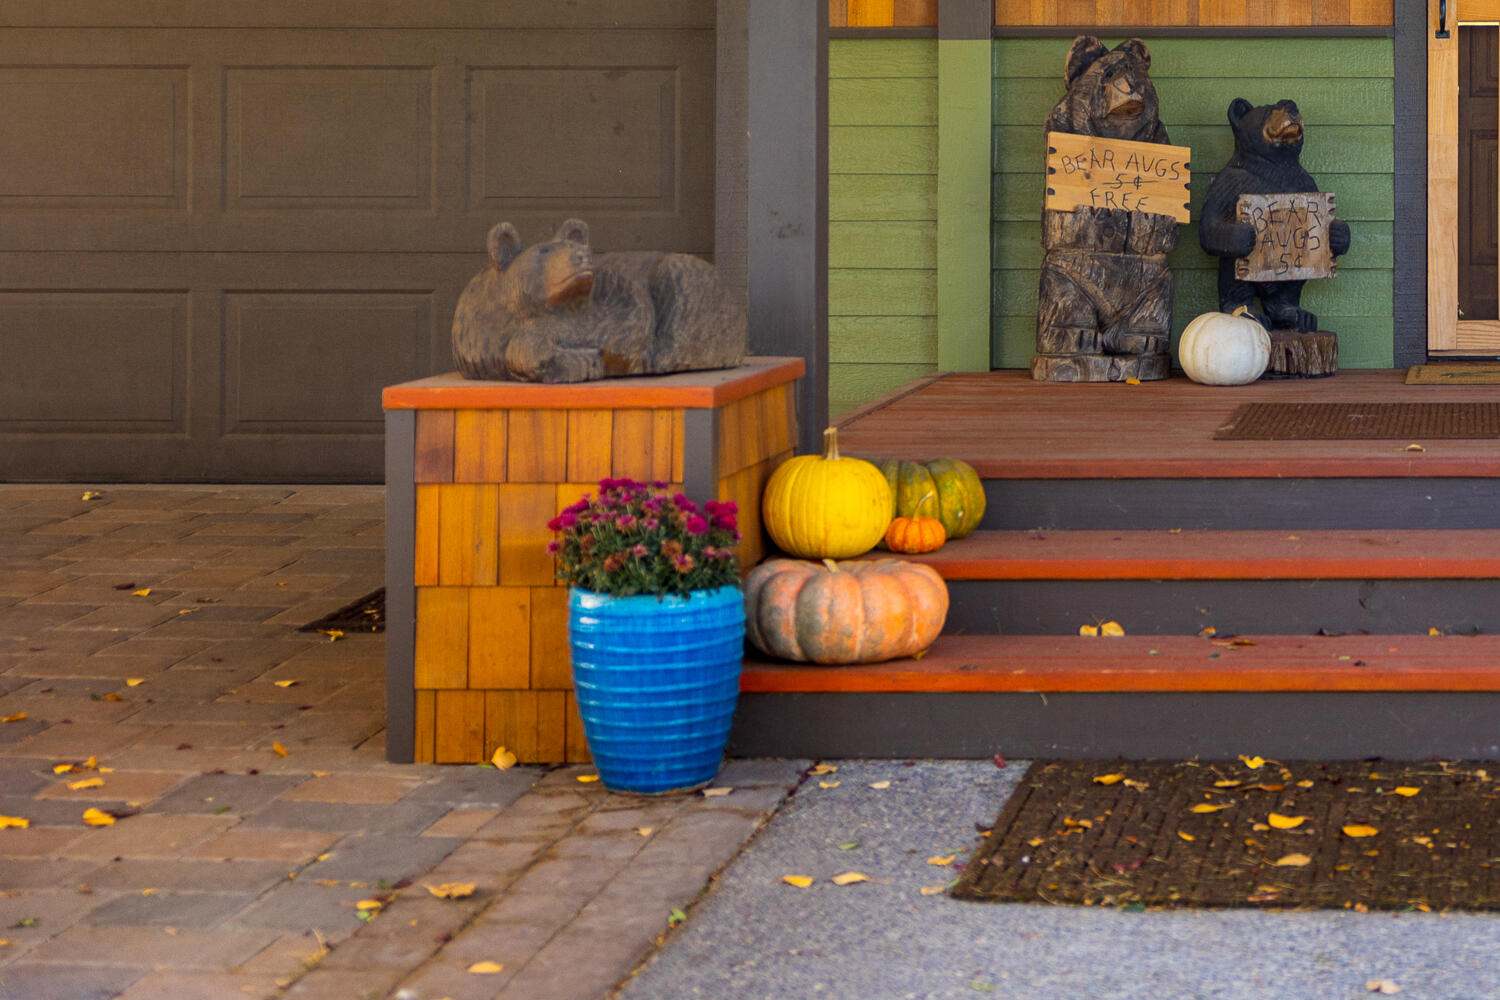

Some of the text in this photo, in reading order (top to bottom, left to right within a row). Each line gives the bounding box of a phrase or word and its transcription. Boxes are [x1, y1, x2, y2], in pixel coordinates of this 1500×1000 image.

[1061, 148, 1116, 175] BEAR
[1090, 187, 1149, 212] FREE
[1252, 199, 1322, 234] BEAR
